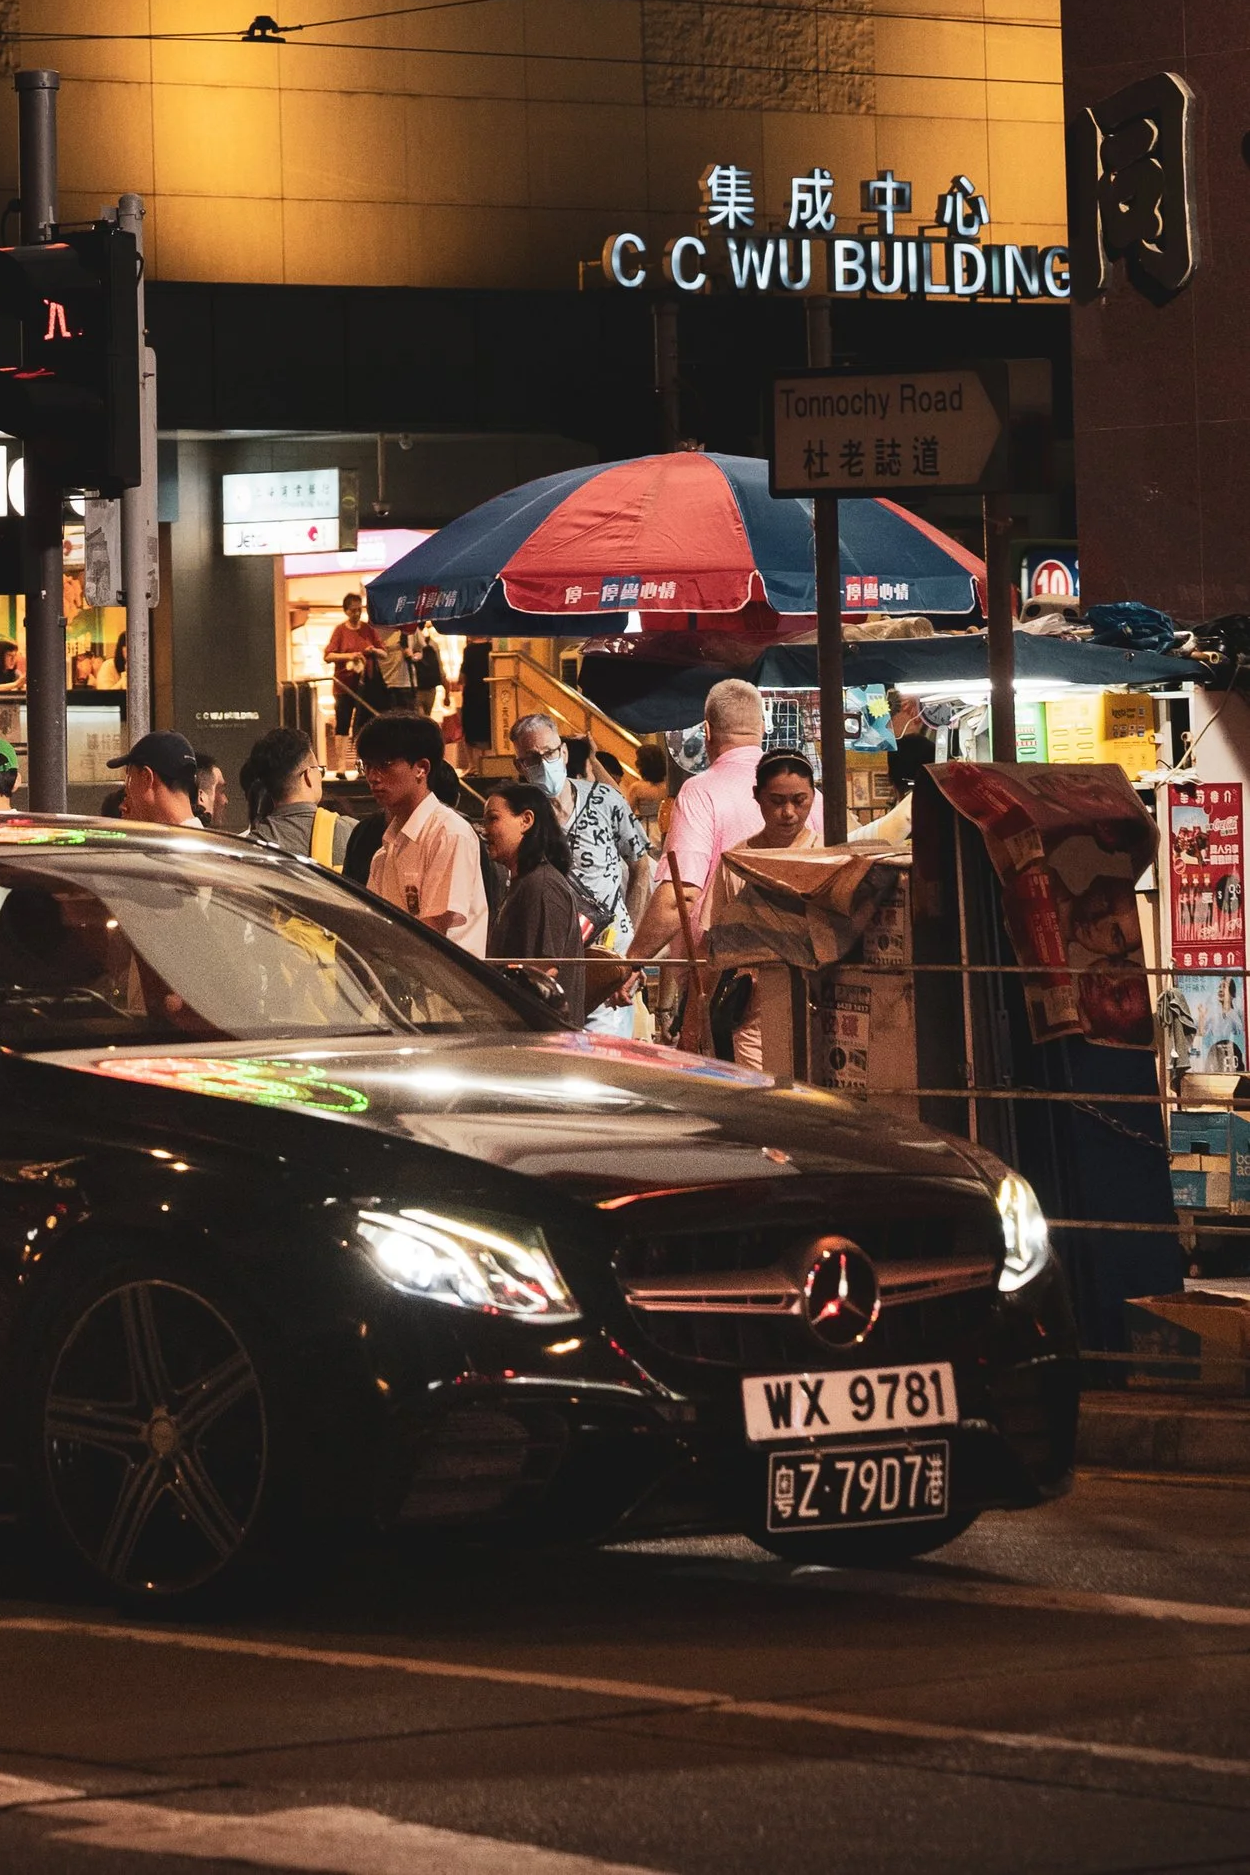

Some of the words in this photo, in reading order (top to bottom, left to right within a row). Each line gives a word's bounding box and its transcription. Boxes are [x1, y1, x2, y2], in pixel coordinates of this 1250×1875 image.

[699, 163, 990, 237] 集成中心
[606, 232, 648, 290] C
[666, 235, 707, 291] C
[726, 236, 811, 291] WU
[833, 239, 1071, 298] BUILDING
[780, 386, 890, 420] Tonnochy
[900, 382, 964, 414] Road
[803, 435, 940, 480] 杜老誌道
[763, 1378, 830, 1429] WX
[847, 1370, 945, 1422] 9781
